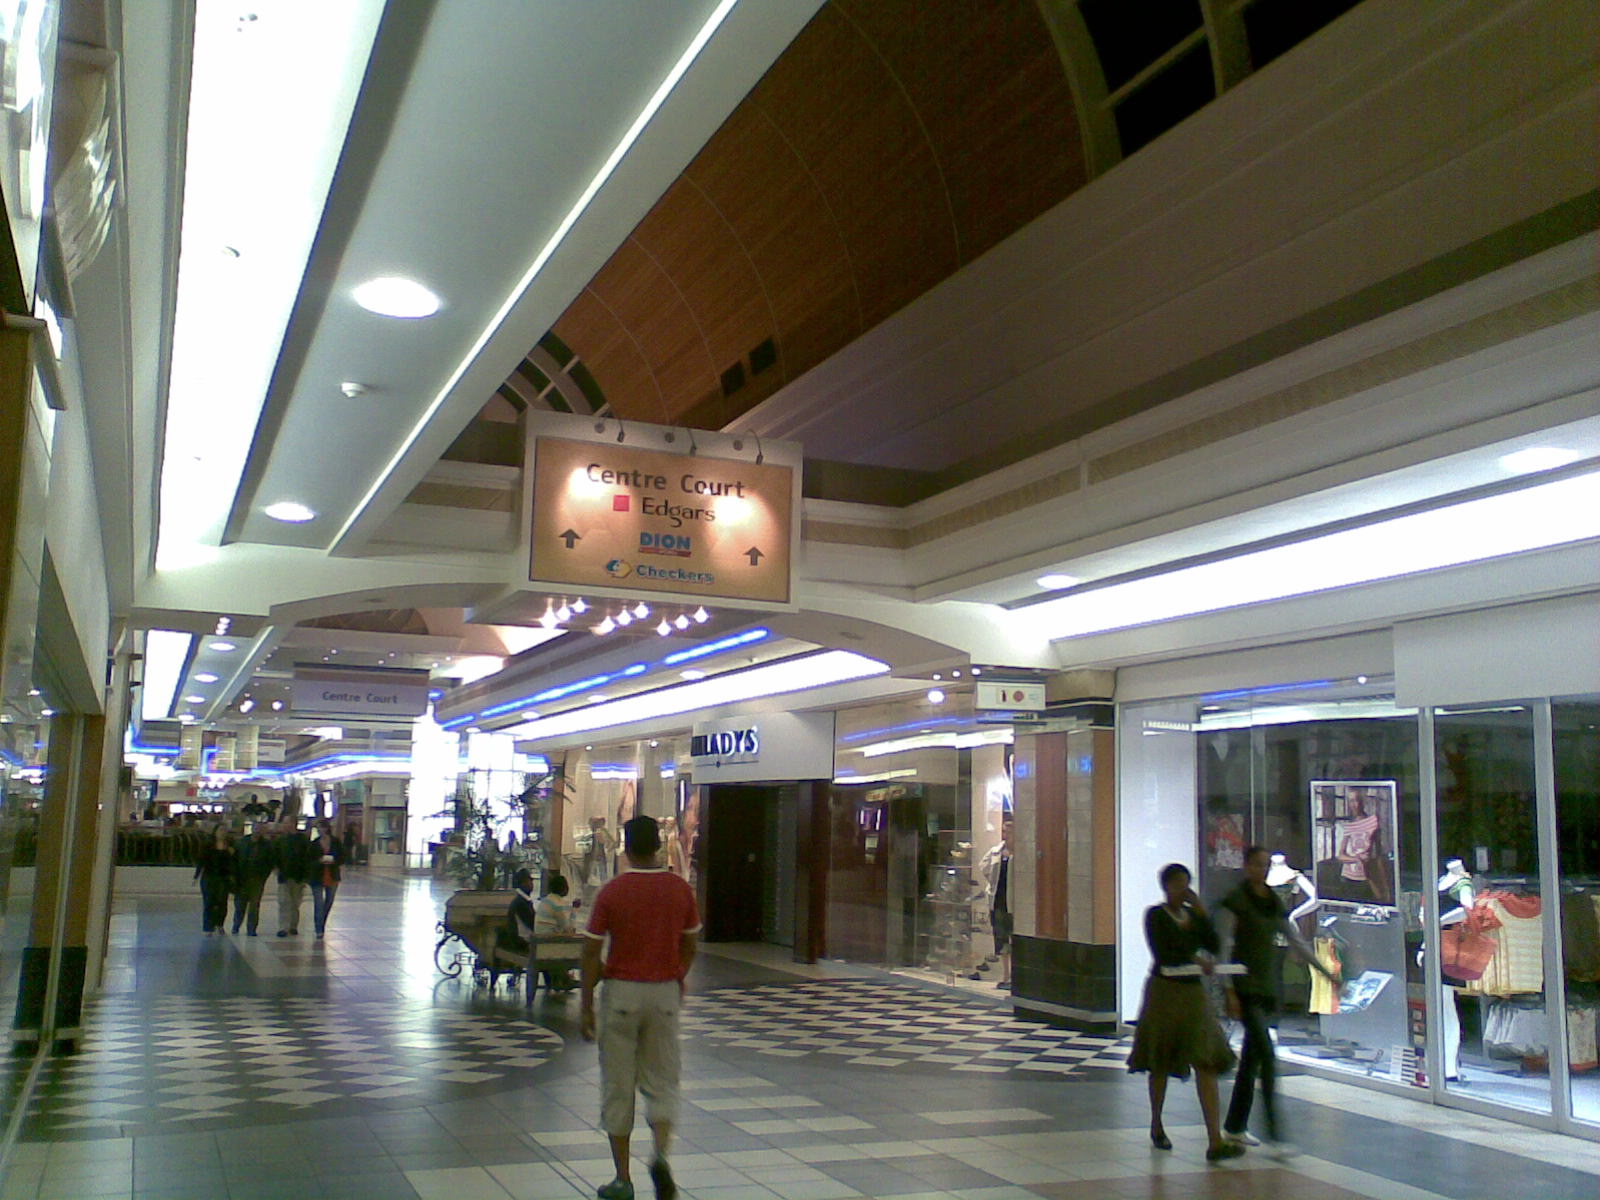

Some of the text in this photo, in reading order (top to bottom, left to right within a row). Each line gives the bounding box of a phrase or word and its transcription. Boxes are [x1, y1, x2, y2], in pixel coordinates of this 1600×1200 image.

[587, 463, 745, 498] Centre Court
[642, 497, 716, 528] Edgars
[640, 532, 690, 549] DION
[636, 564, 715, 582] Checkers
[322, 691, 398, 704] Centre Court
